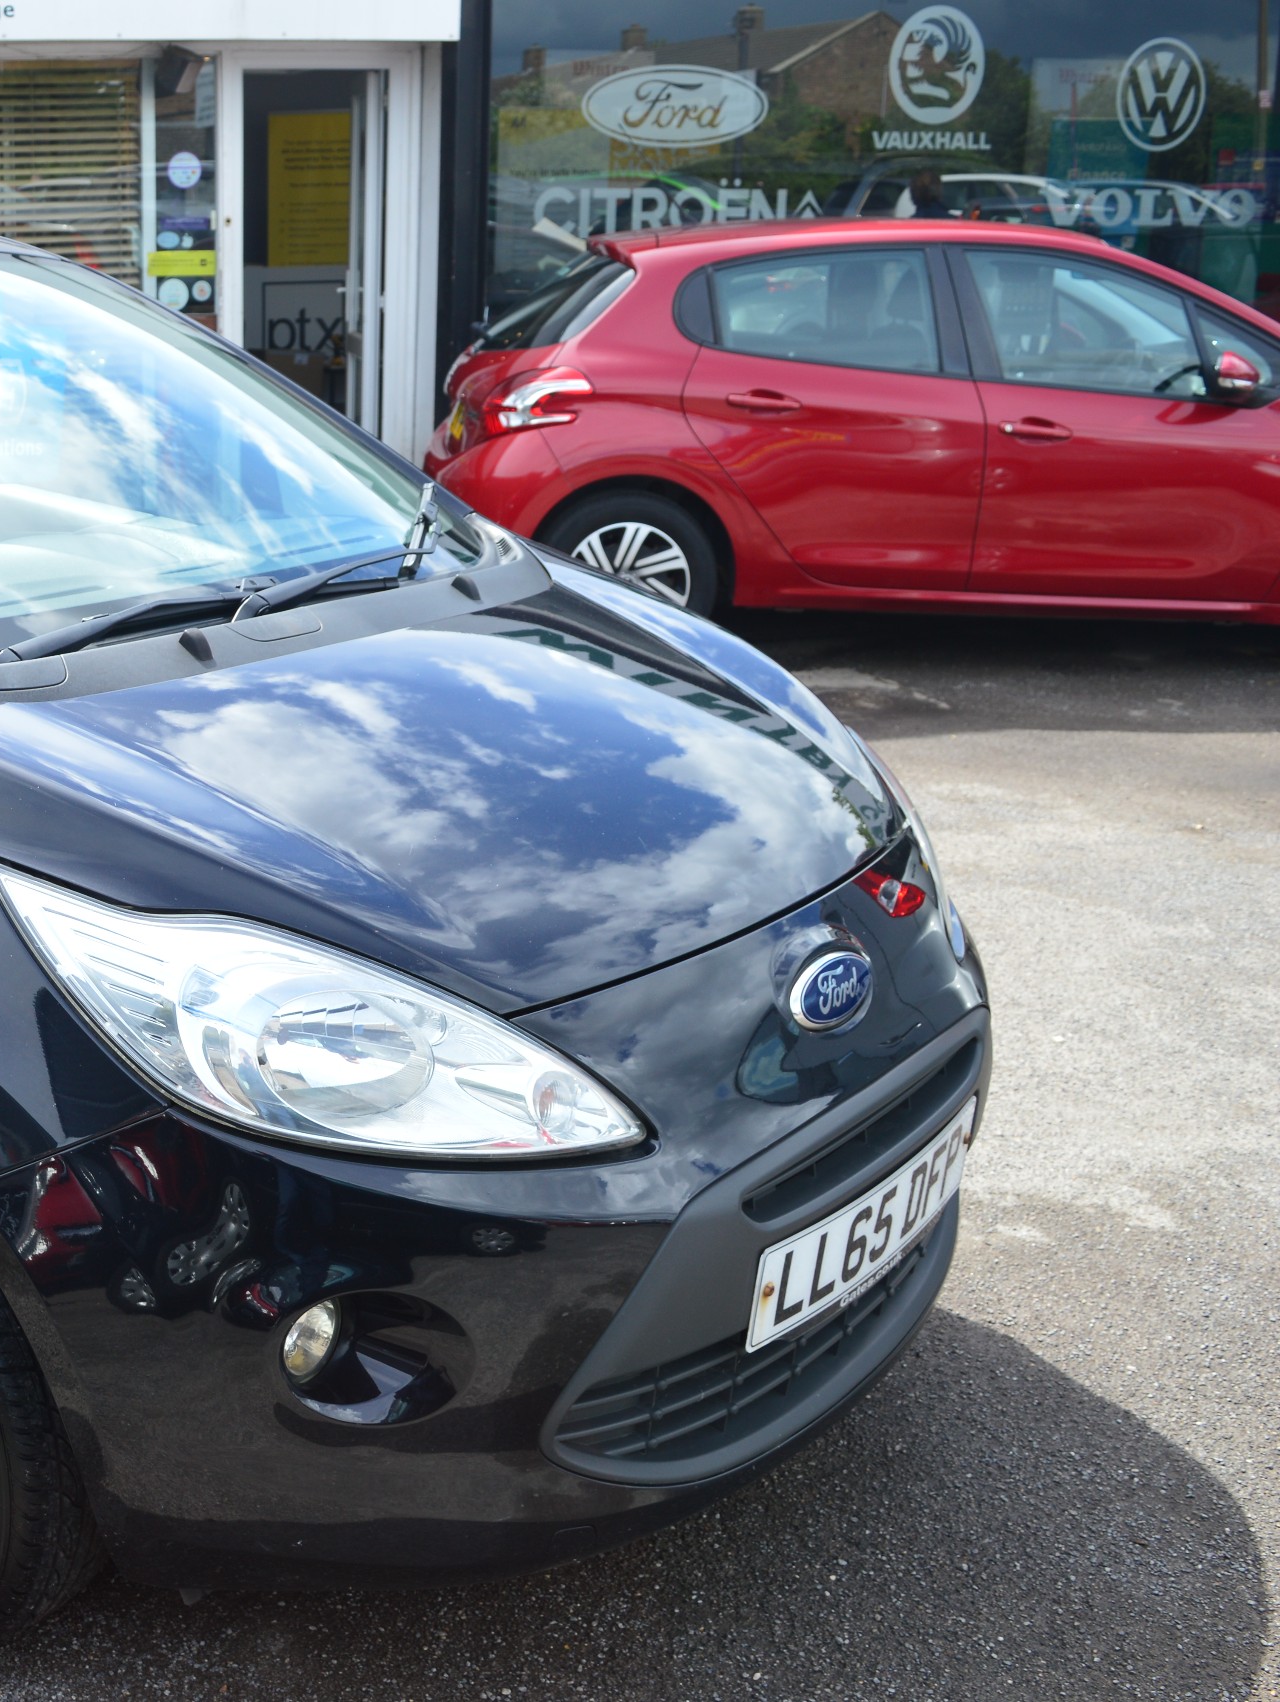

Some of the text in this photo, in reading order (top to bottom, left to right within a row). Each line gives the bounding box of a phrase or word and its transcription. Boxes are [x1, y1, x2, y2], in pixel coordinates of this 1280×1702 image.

[622, 78, 728, 129] Ford
[871, 130, 992, 150] VAUXHALL
[533, 178, 788, 237] CITROËN
[1038, 187, 1257, 227] VOLVO
[817, 964, 860, 1015] Ford
[773, 1124, 963, 1327] LL65 DFP
